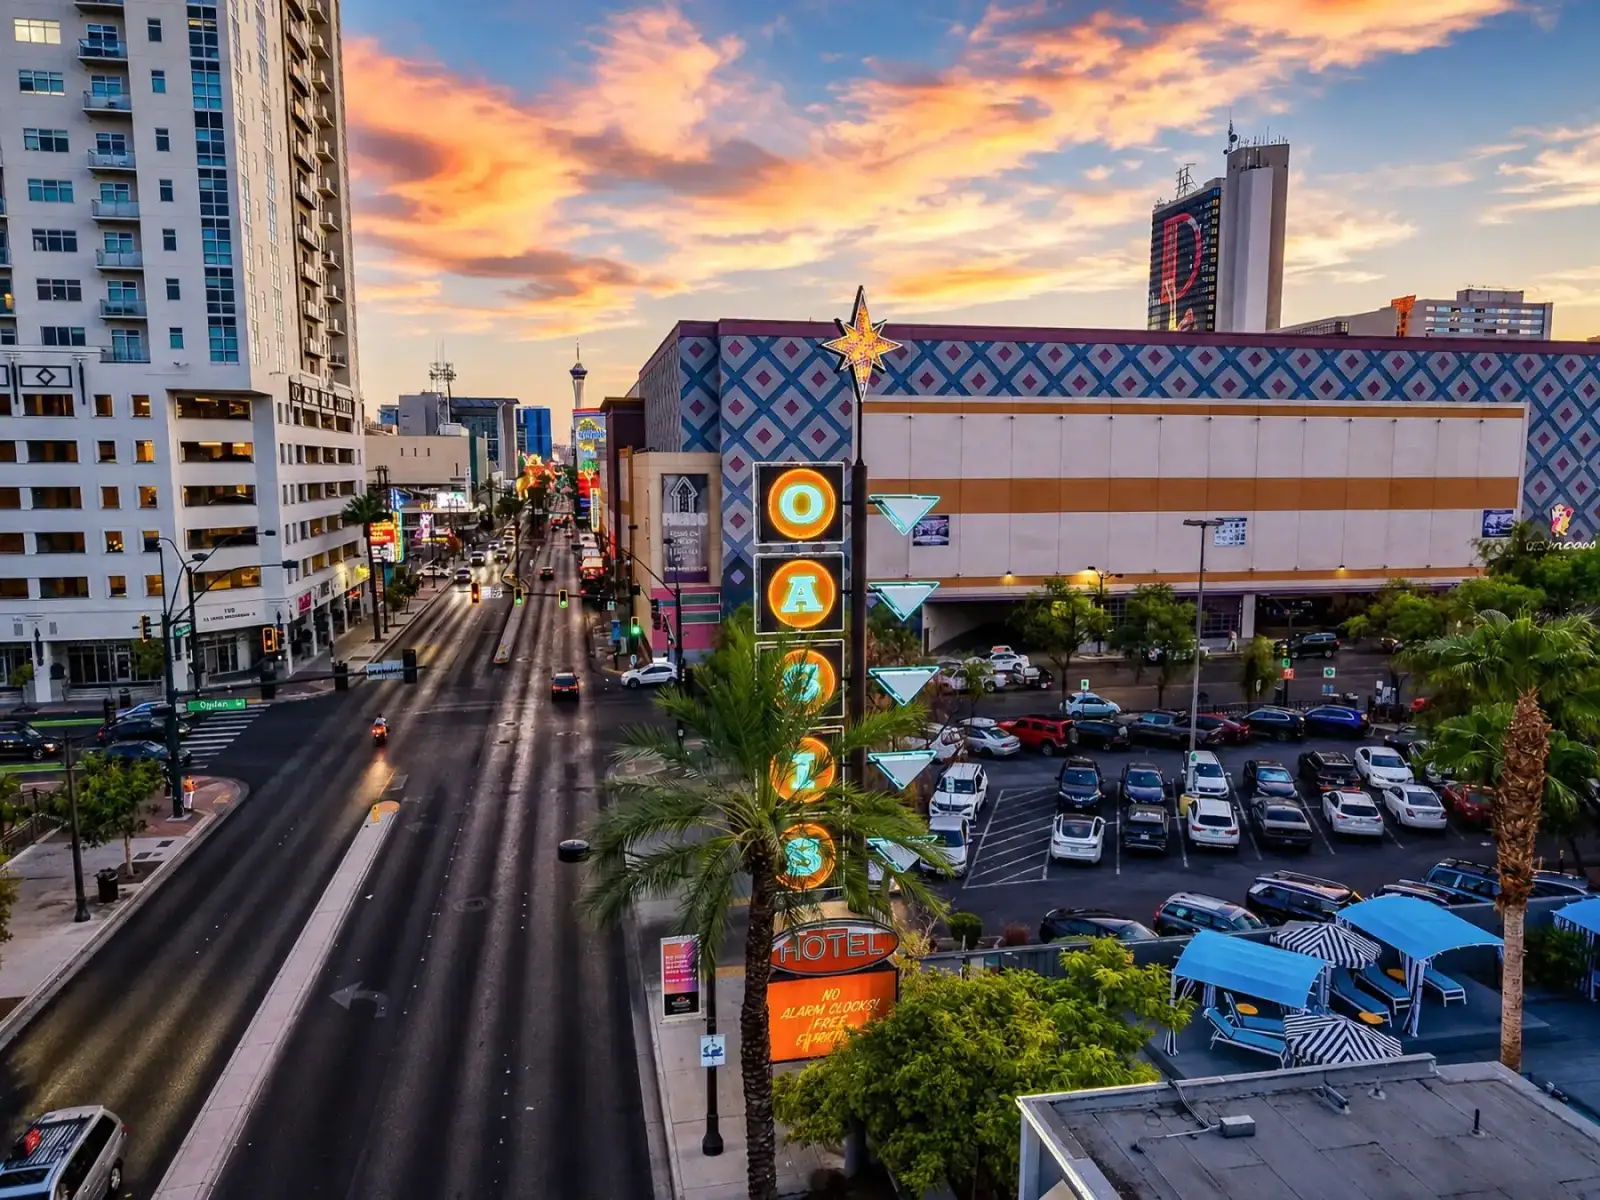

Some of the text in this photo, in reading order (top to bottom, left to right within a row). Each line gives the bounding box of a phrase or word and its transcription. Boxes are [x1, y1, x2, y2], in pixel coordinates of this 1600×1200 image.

[780, 932, 884, 963] HOTEL
[821, 988, 841, 1001] NO
[780, 1004, 825, 1020] ALARM
[812, 1015, 848, 1029] FREE
